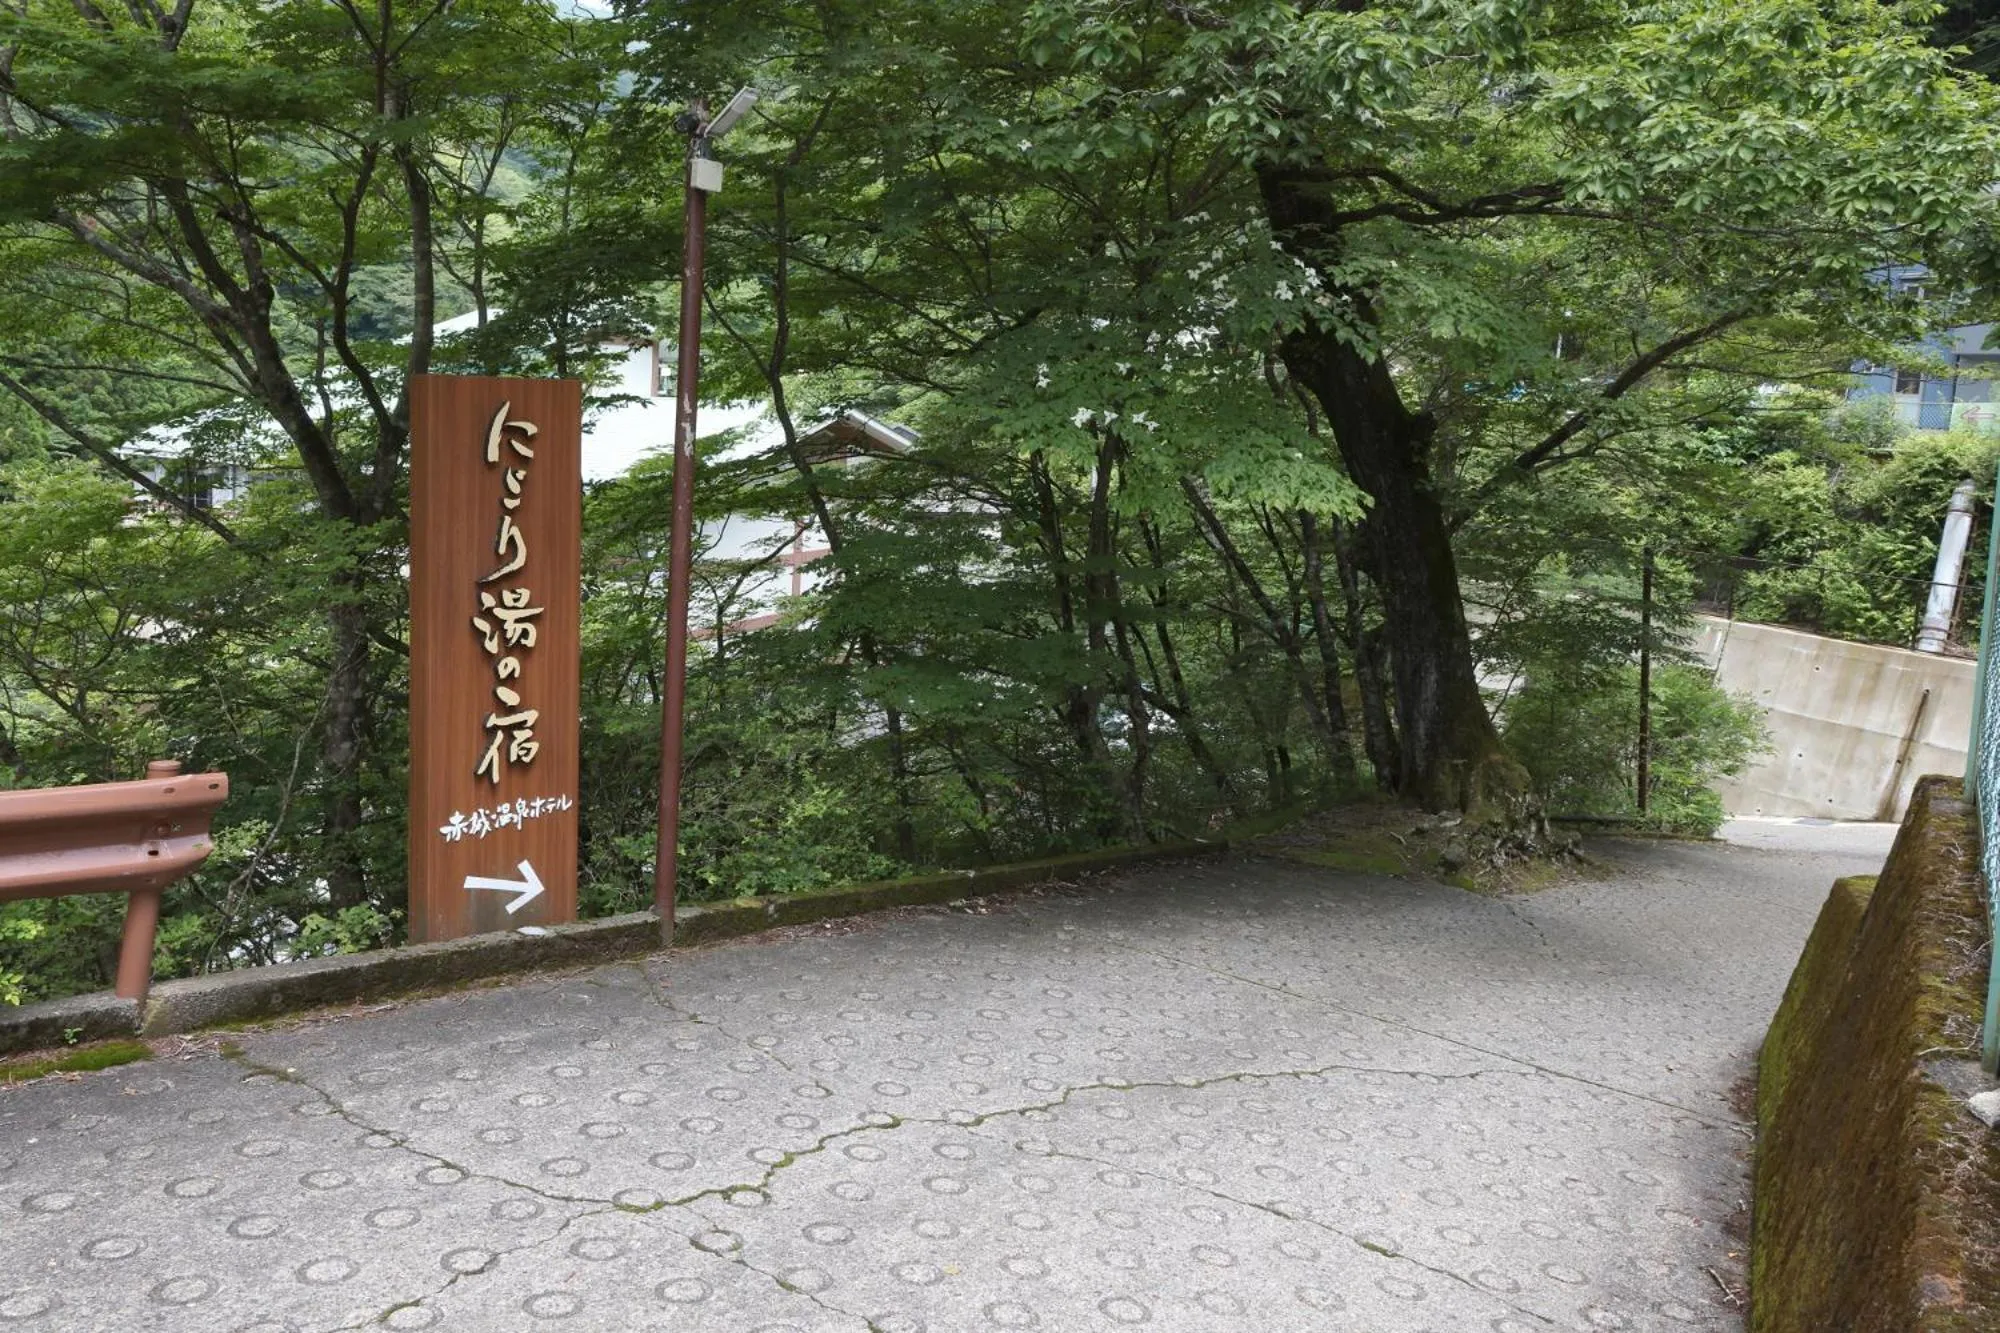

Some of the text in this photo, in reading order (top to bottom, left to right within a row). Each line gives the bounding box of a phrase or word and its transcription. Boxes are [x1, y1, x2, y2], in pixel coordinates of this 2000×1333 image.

[473, 400, 545, 784] にごり湯の宿
[439, 793, 573, 843] 赤城温泉ホテル
